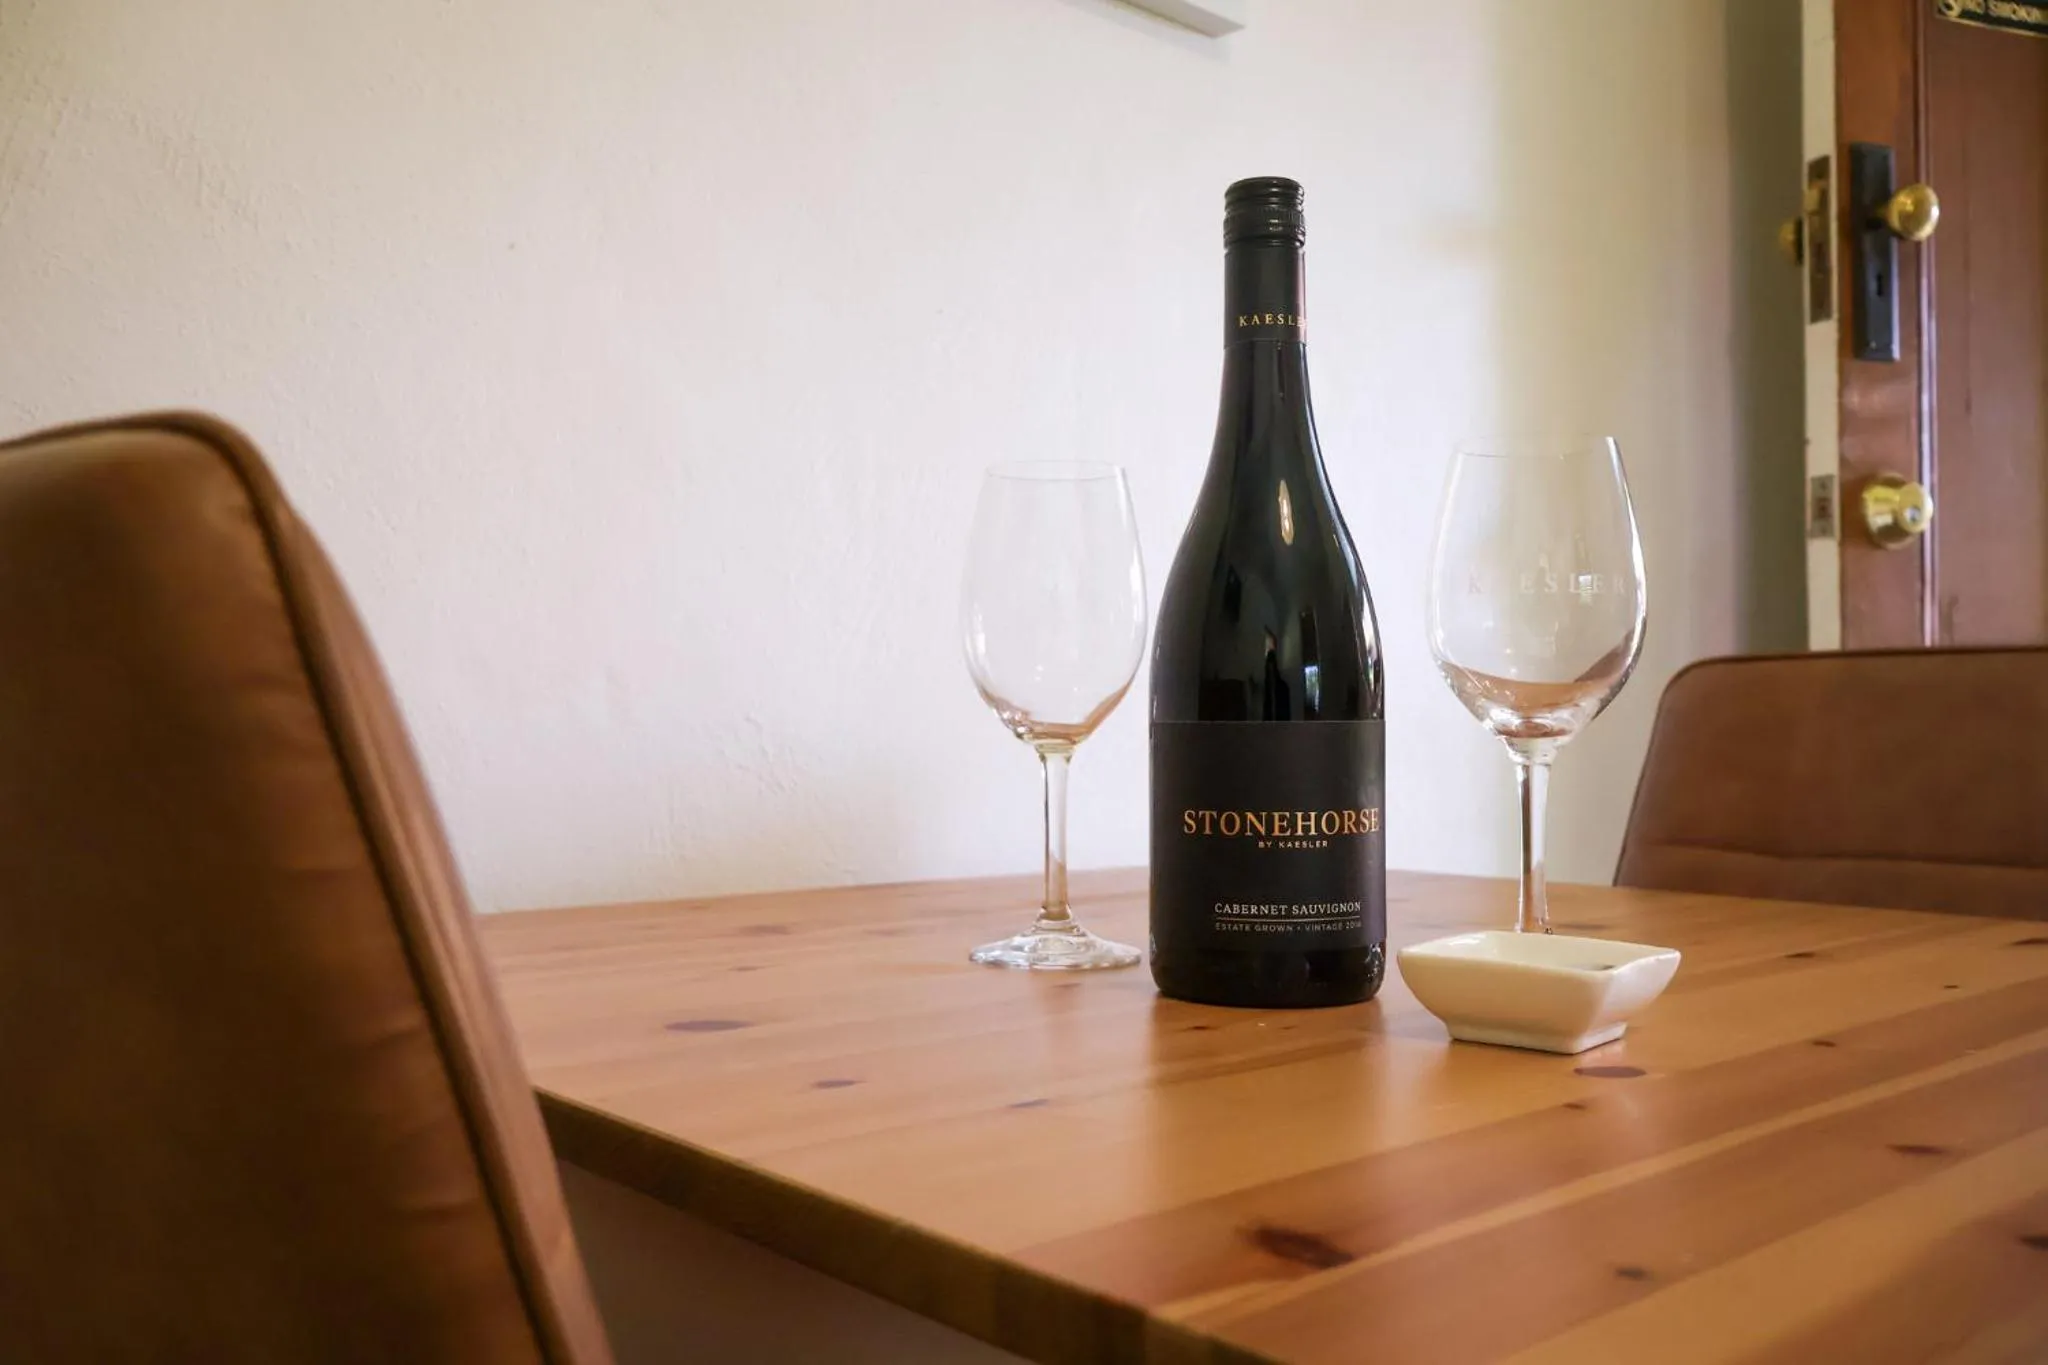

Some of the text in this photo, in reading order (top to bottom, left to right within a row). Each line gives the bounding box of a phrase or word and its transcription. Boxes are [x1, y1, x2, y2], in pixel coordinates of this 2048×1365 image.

[1183, 808, 1380, 836] STONEHORSE
[1258, 840, 1328, 849] BY KAESLER
[1214, 901, 1362, 916] CABERNET SAUVIGNON
[1215, 922, 1250, 932] ESTATE
[1254, 923, 1293, 933] GROWN
[1306, 922, 1343, 932] VINTAGE
